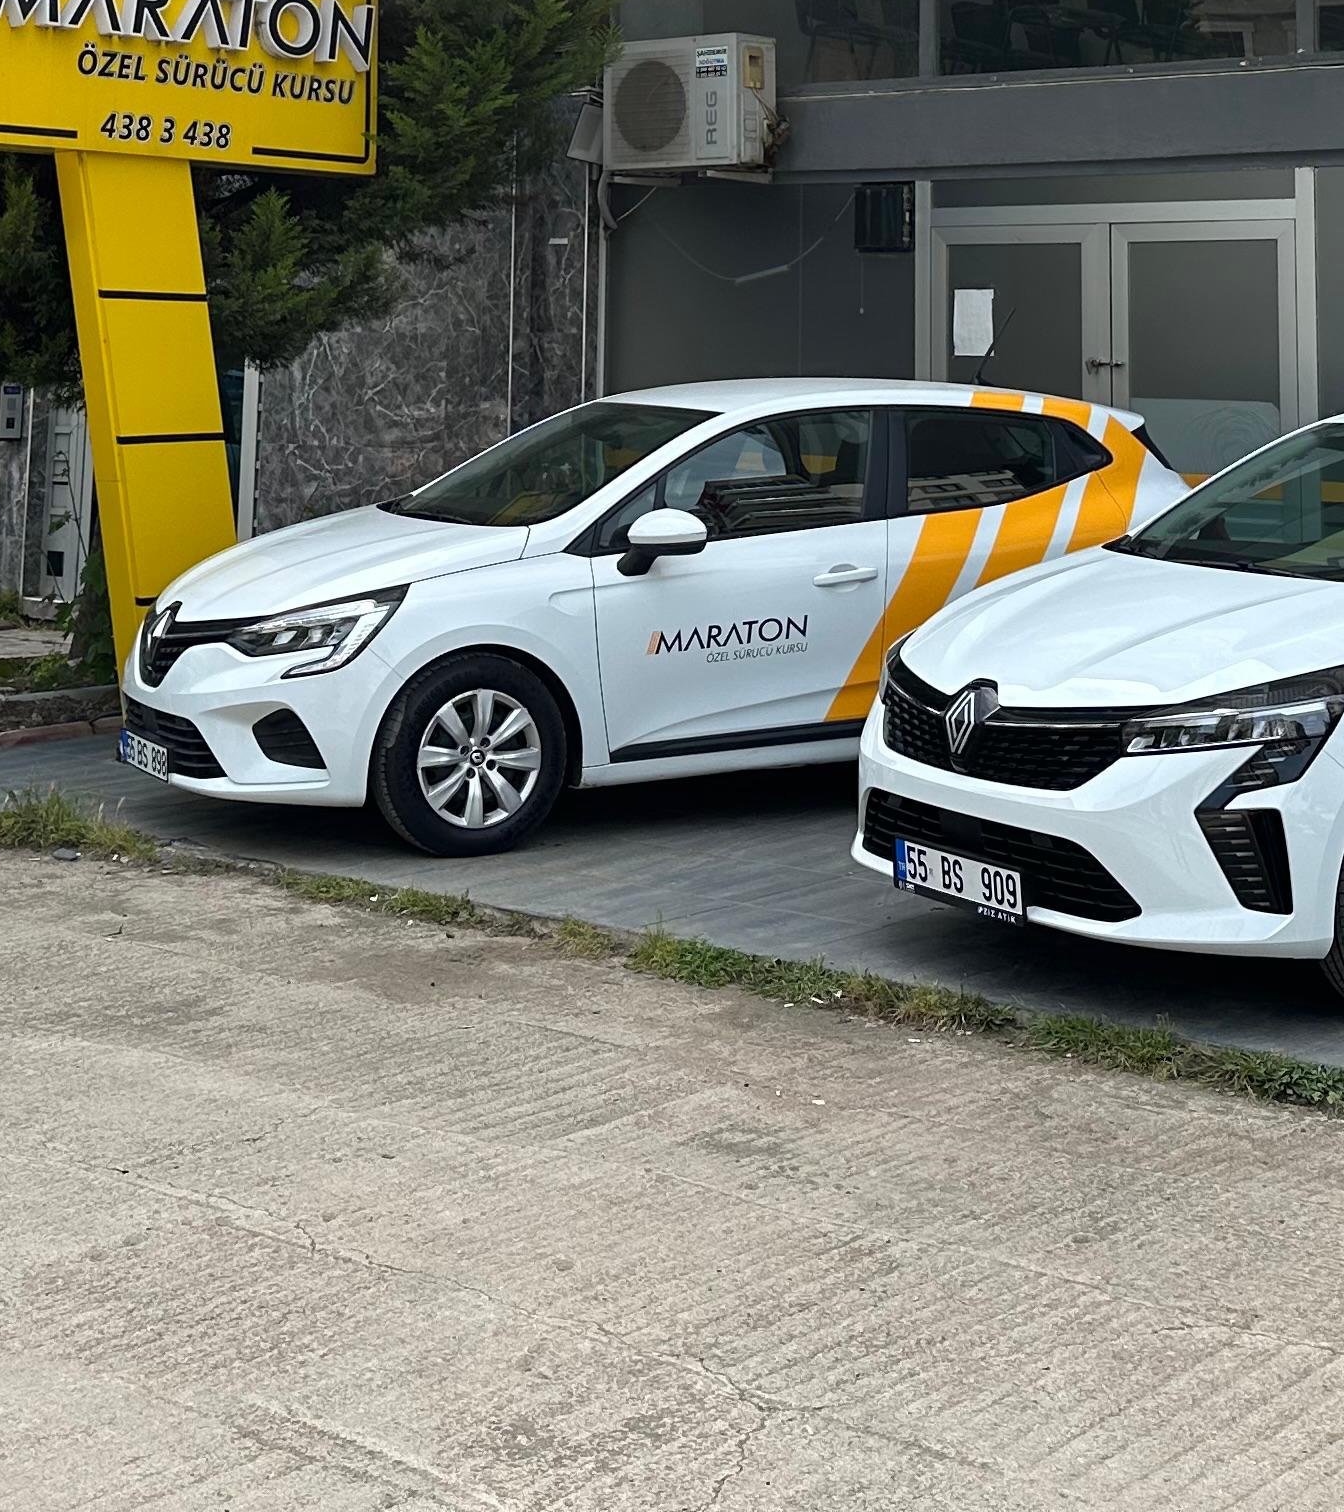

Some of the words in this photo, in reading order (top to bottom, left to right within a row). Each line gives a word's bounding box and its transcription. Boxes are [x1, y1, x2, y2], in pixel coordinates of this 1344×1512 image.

[77, 41, 147, 83] ÖZEL
[156, 55, 266, 95] SÜRÜCÜ
[271, 71, 357, 106] KURSU
[101, 112, 152, 144] 438
[159, 118, 175, 146] 3
[182, 120, 233, 150] 438
[655, 614, 809, 655] MARATON
[706, 650, 731, 663] ÖZEL
[775, 642, 809, 655] KURSU
[137, 739, 148, 769] BS
[906, 845, 928, 883] 55
[940, 855, 964, 894] BS
[980, 866, 1017, 909] 909
